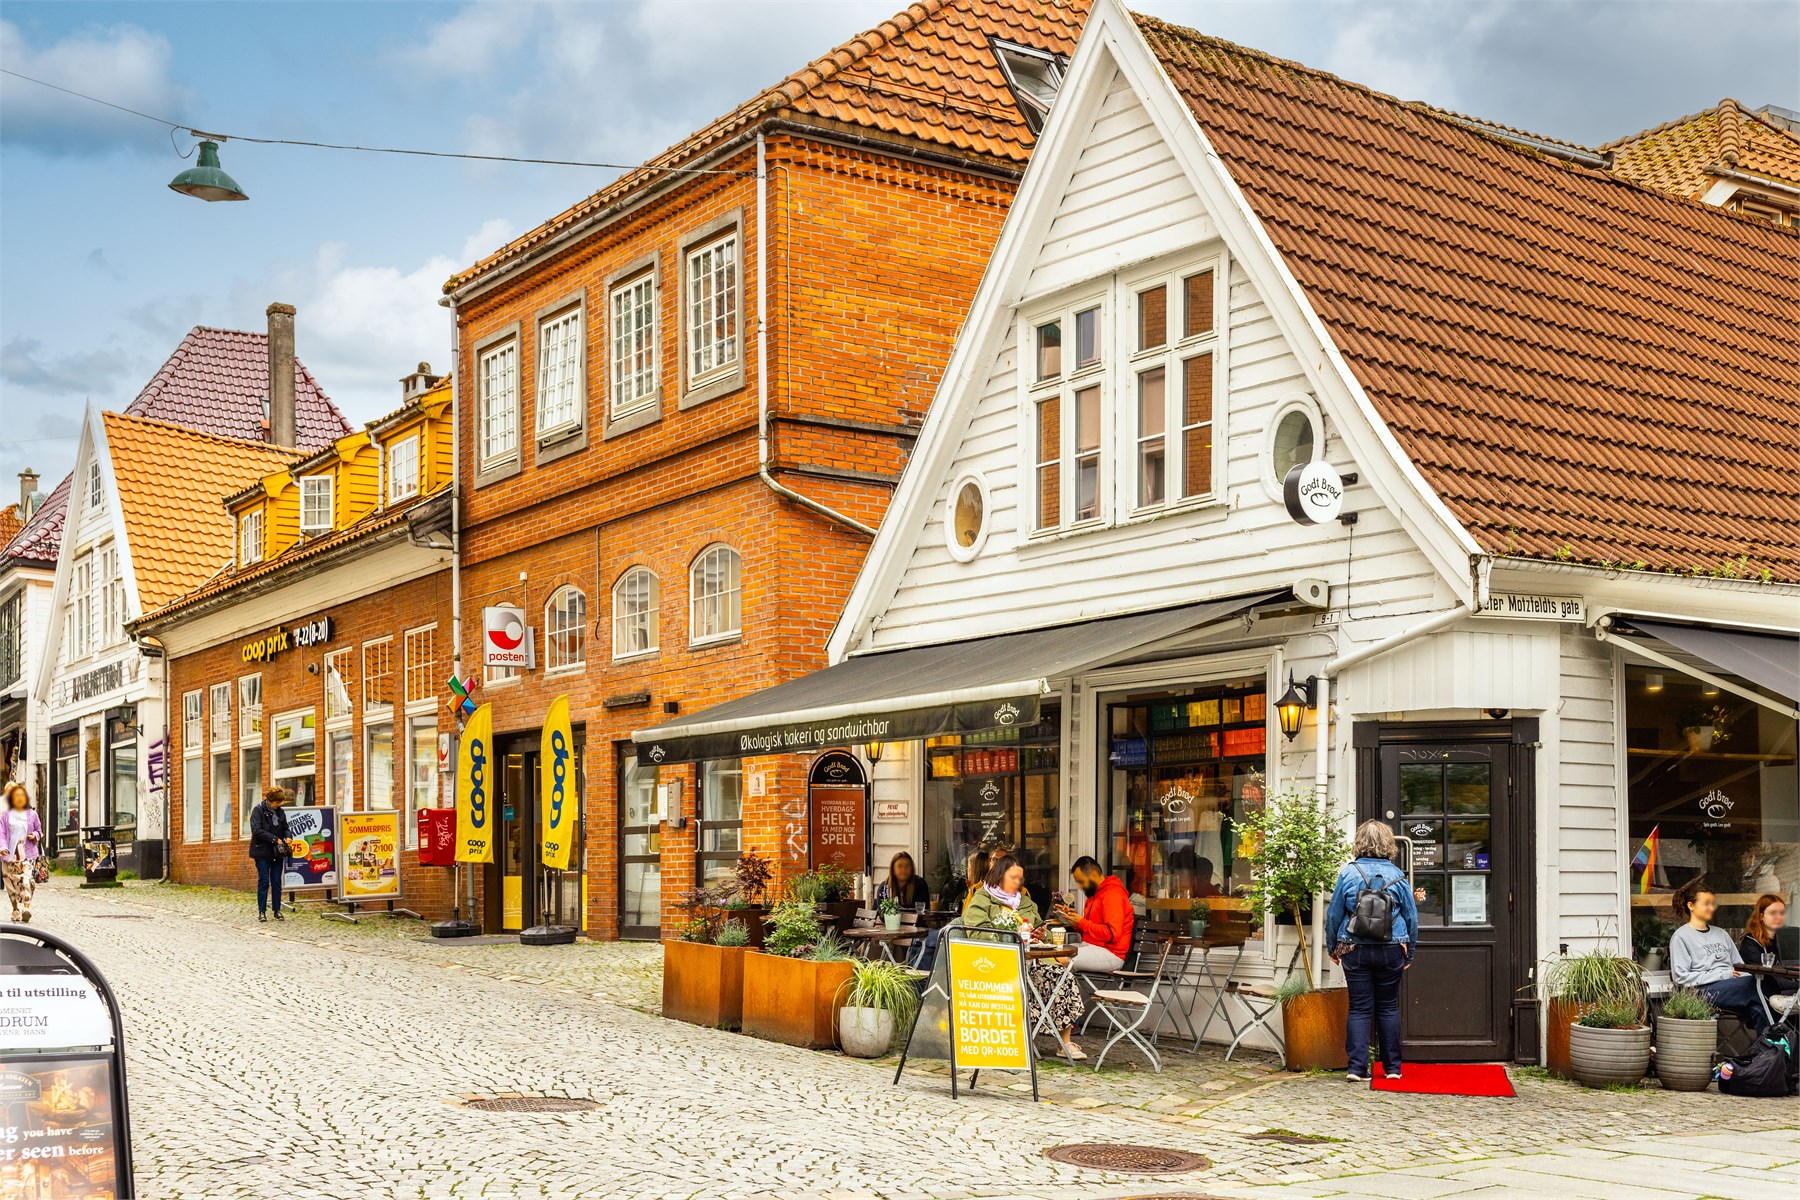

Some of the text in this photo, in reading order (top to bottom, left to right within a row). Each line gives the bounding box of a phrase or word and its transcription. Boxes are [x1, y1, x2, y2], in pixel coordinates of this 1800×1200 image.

[1301, 477, 1341, 499] Godt Brød
[1508, 595, 1557, 614] Motzfeldts
[1561, 600, 1580, 618] gate
[242, 626, 288, 662] coop prix
[489, 652, 525, 663] posten
[740, 719, 889, 751] Økologisk bakeri og sandwichbar
[470, 738, 487, 829] coop
[550, 729, 570, 829] coop
[1160, 785, 1195, 806] Godt Brød
[1699, 789, 1735, 810] Godt Brød
[821, 805, 855, 813] HVERDAGS-
[821, 813, 856, 826] HELT:
[348, 824, 392, 834] SOMMERPRIS
[467, 839, 486, 849] coop
[821, 833, 856, 845] SPELT
[468, 846, 483, 855] prix
[544, 840, 559, 852] coop
[958, 979, 1013, 993] VELKOMMEN
[7, 988, 86, 1000] til utstilling
[958, 991, 966, 999] TIL
[959, 998, 967, 1007] NÅ
[991, 1003, 1016, 1011] BESTILLE
[960, 1010, 1016, 1027] RETT TIL
[961, 1027, 1017, 1045] BORDET
[961, 1045, 1019, 1057] MED QR-KODE
[23, 1130, 44, 1140] you
[47, 1127, 73, 1136] have
[21, 1145, 65, 1159] seen
[69, 1145, 104, 1155] before
